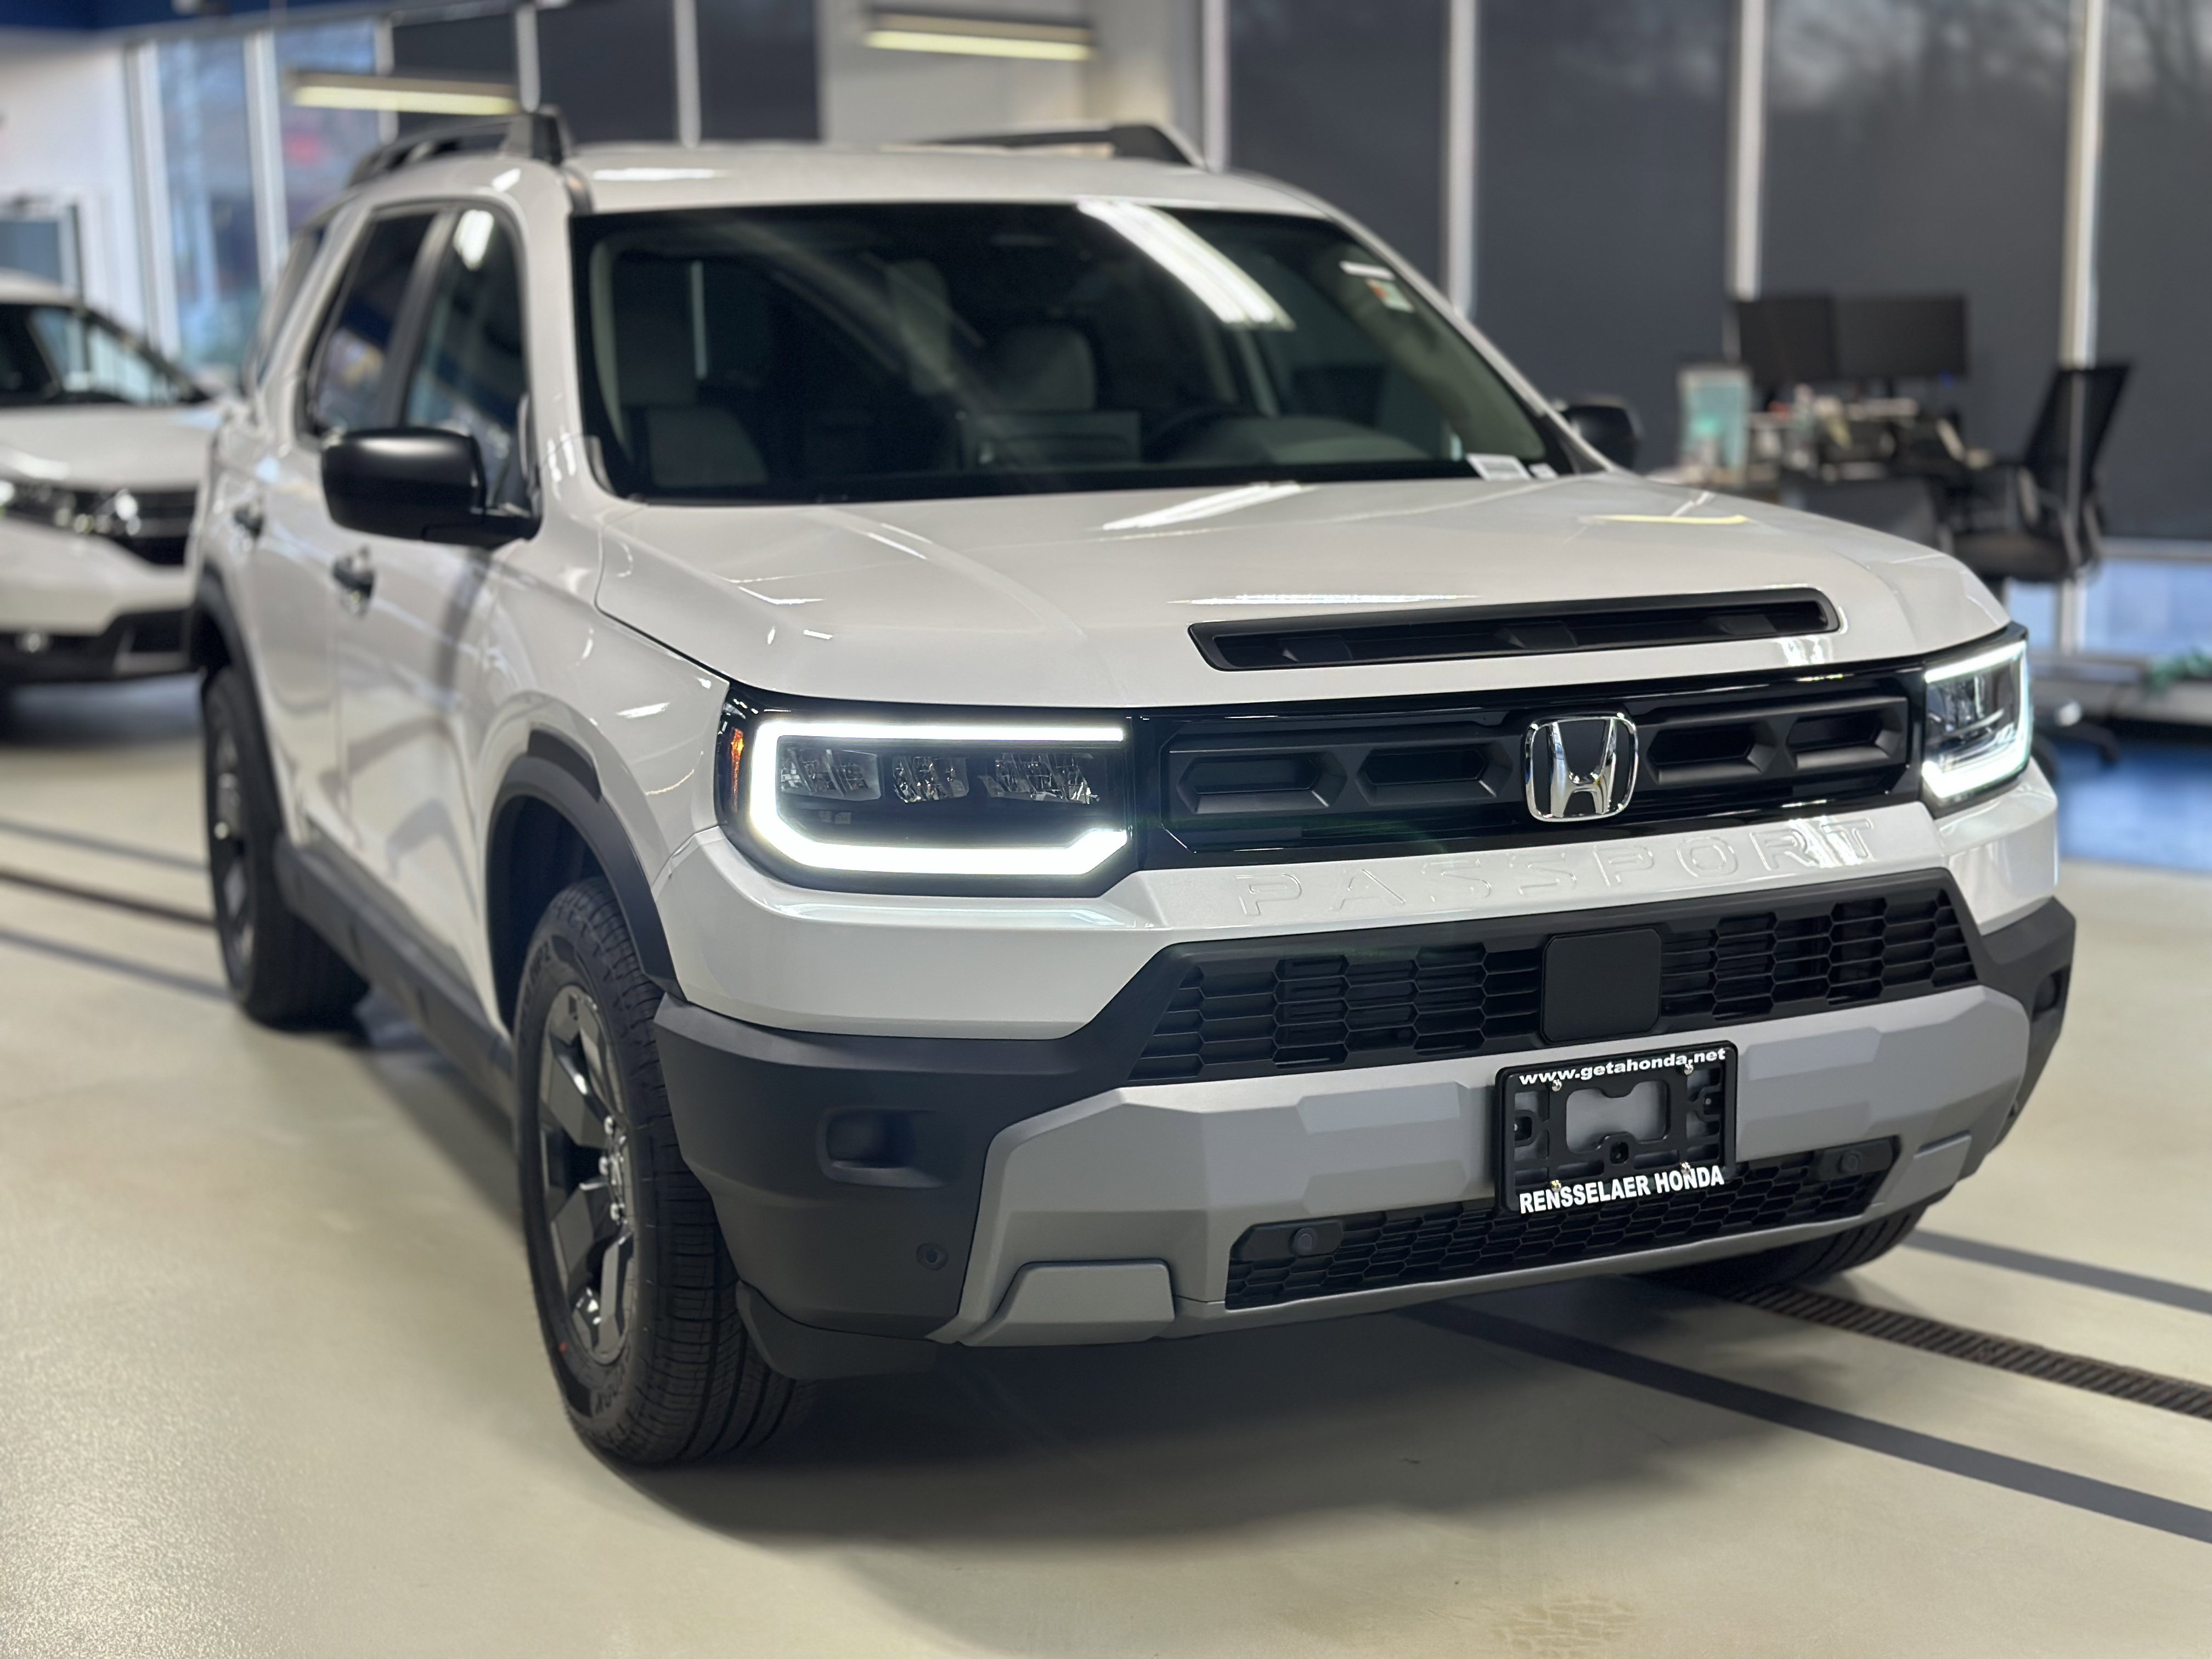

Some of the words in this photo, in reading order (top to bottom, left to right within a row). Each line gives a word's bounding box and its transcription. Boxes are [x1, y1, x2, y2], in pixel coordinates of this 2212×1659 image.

[1234, 816, 1876, 917] PASSPORT
[1519, 1048, 1726, 1086] www.getahonda.net
[1519, 1175, 1651, 1214] RENSSELAER
[1655, 1165, 1725, 1193] HONDA
